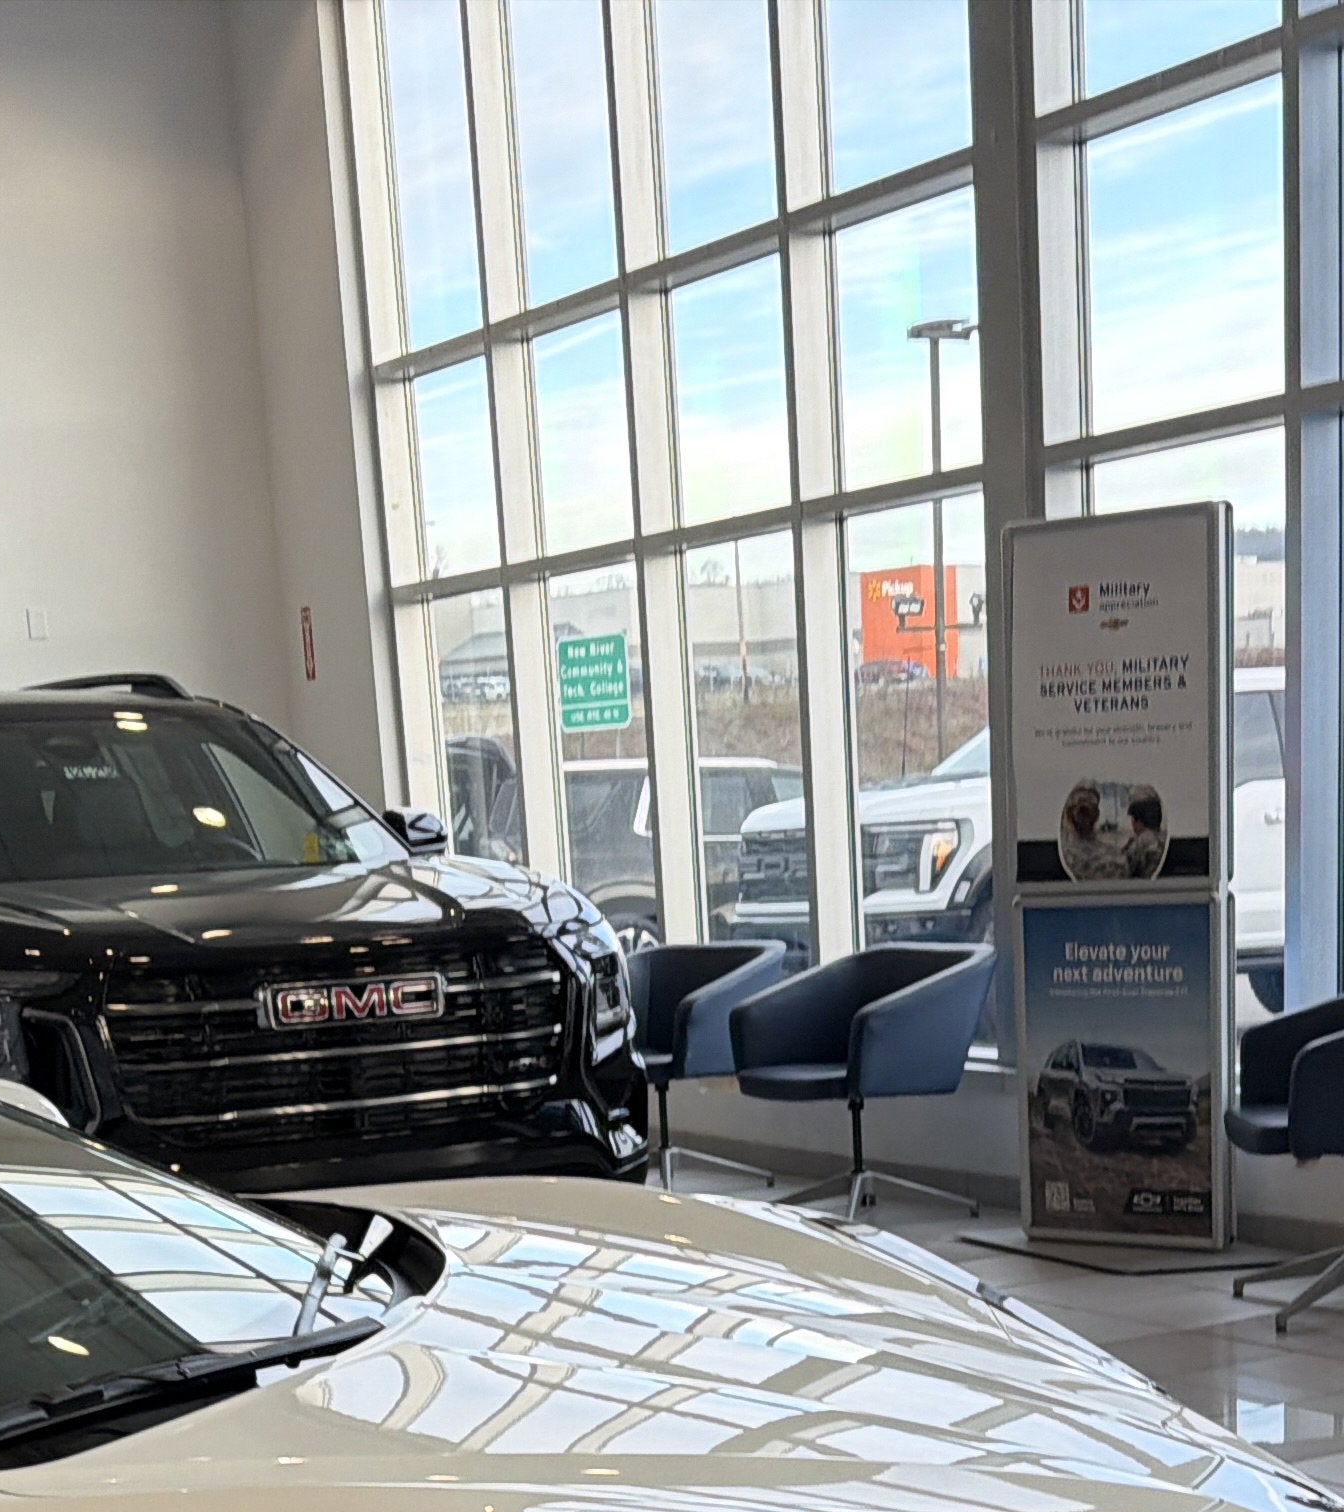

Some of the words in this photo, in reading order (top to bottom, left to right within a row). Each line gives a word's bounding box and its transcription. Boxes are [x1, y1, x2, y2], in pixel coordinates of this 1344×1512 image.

[881, 579, 914, 598] Pickup
[1099, 582, 1150, 598] Military
[1099, 597, 1159, 612] appreciation
[568, 645, 585, 658] New
[589, 641, 614, 656] River
[560, 662, 613, 680] Community
[1040, 662, 1082, 678] THANK
[1122, 654, 1189, 674] MILITARY
[590, 680, 624, 697] College
[1040, 679, 1097, 698] SERVICE
[1102, 675, 1172, 694] MEMBERS
[1177, 673, 1187, 689] &
[1074, 696, 1149, 714] VETERANS
[1064, 941, 1126, 961] Elevate
[1131, 944, 1170, 965] your
[1053, 966, 1088, 984] next
[1092, 963, 1184, 983] adventure
[277, 980, 436, 1024] GMC
